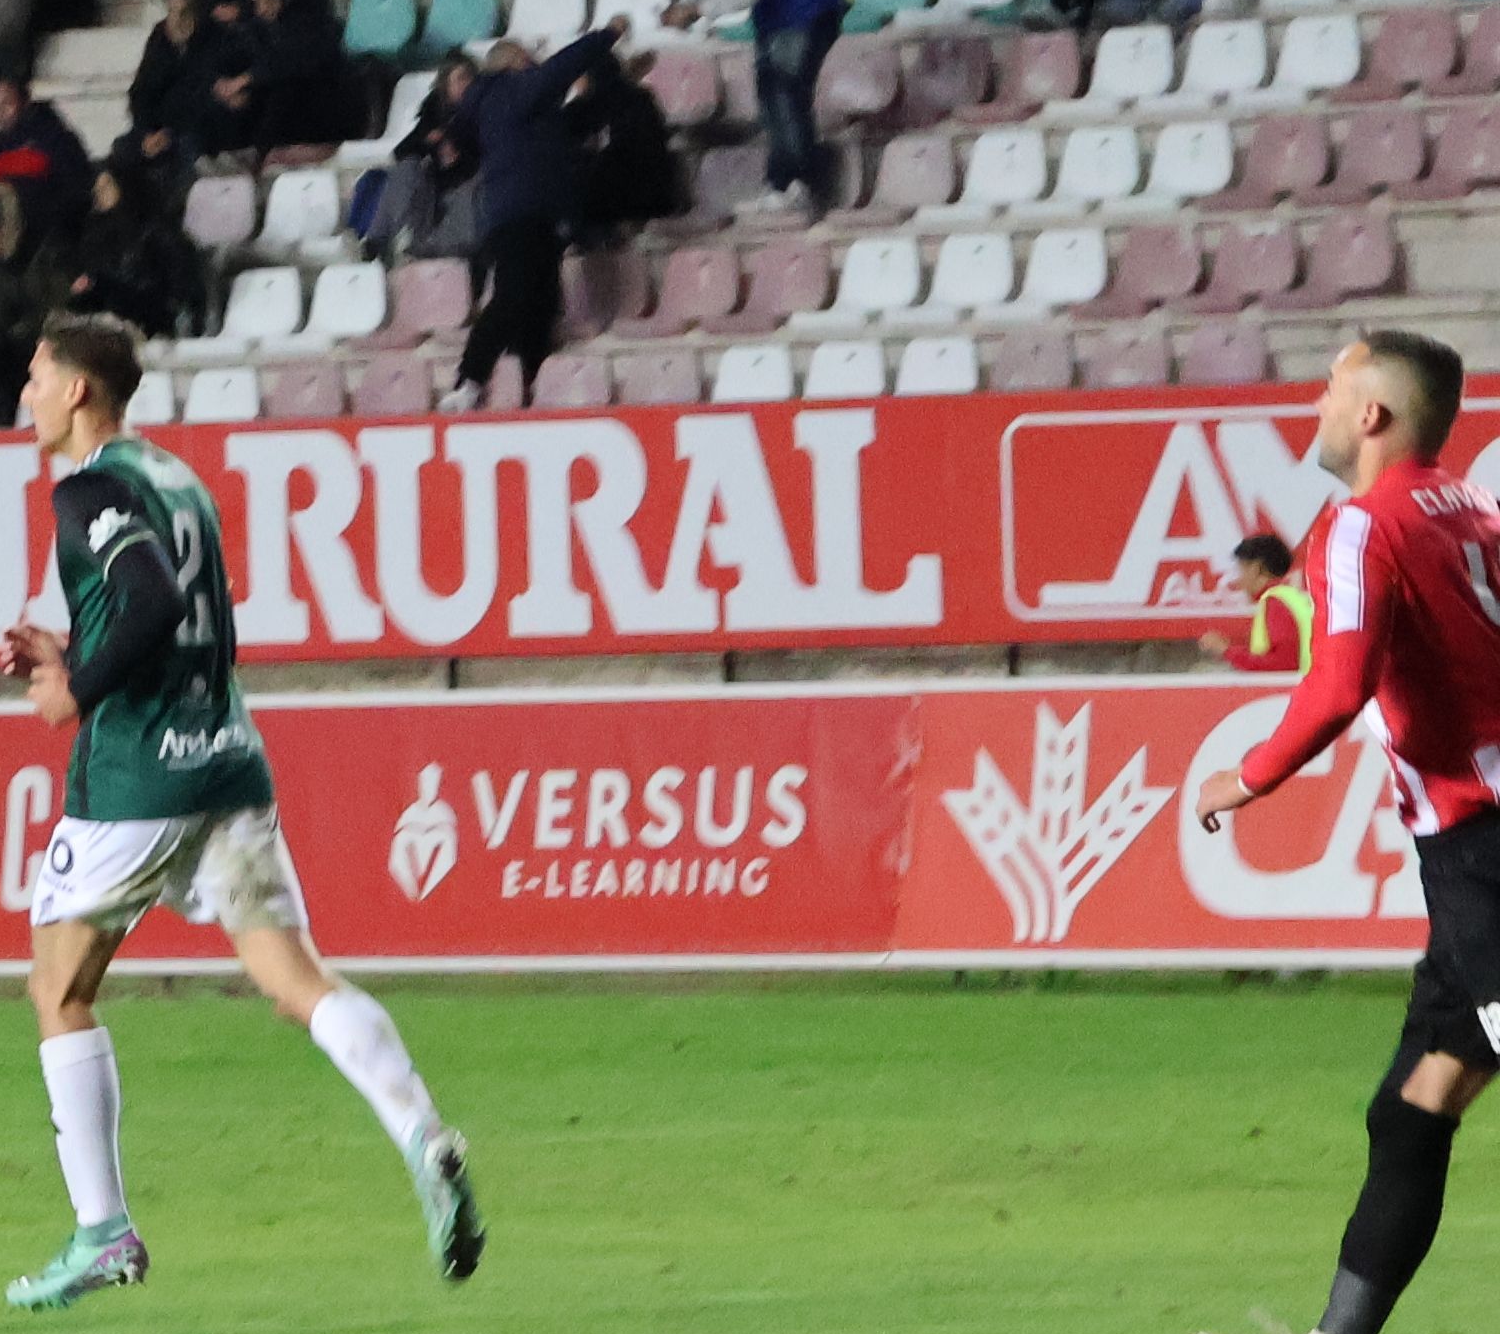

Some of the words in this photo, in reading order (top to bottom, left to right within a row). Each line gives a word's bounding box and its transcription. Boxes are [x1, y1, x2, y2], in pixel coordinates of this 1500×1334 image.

[225, 407, 942, 645] RURAL
[471, 764, 809, 852] VERSUS
[500, 857, 771, 900] E-LEARNING
